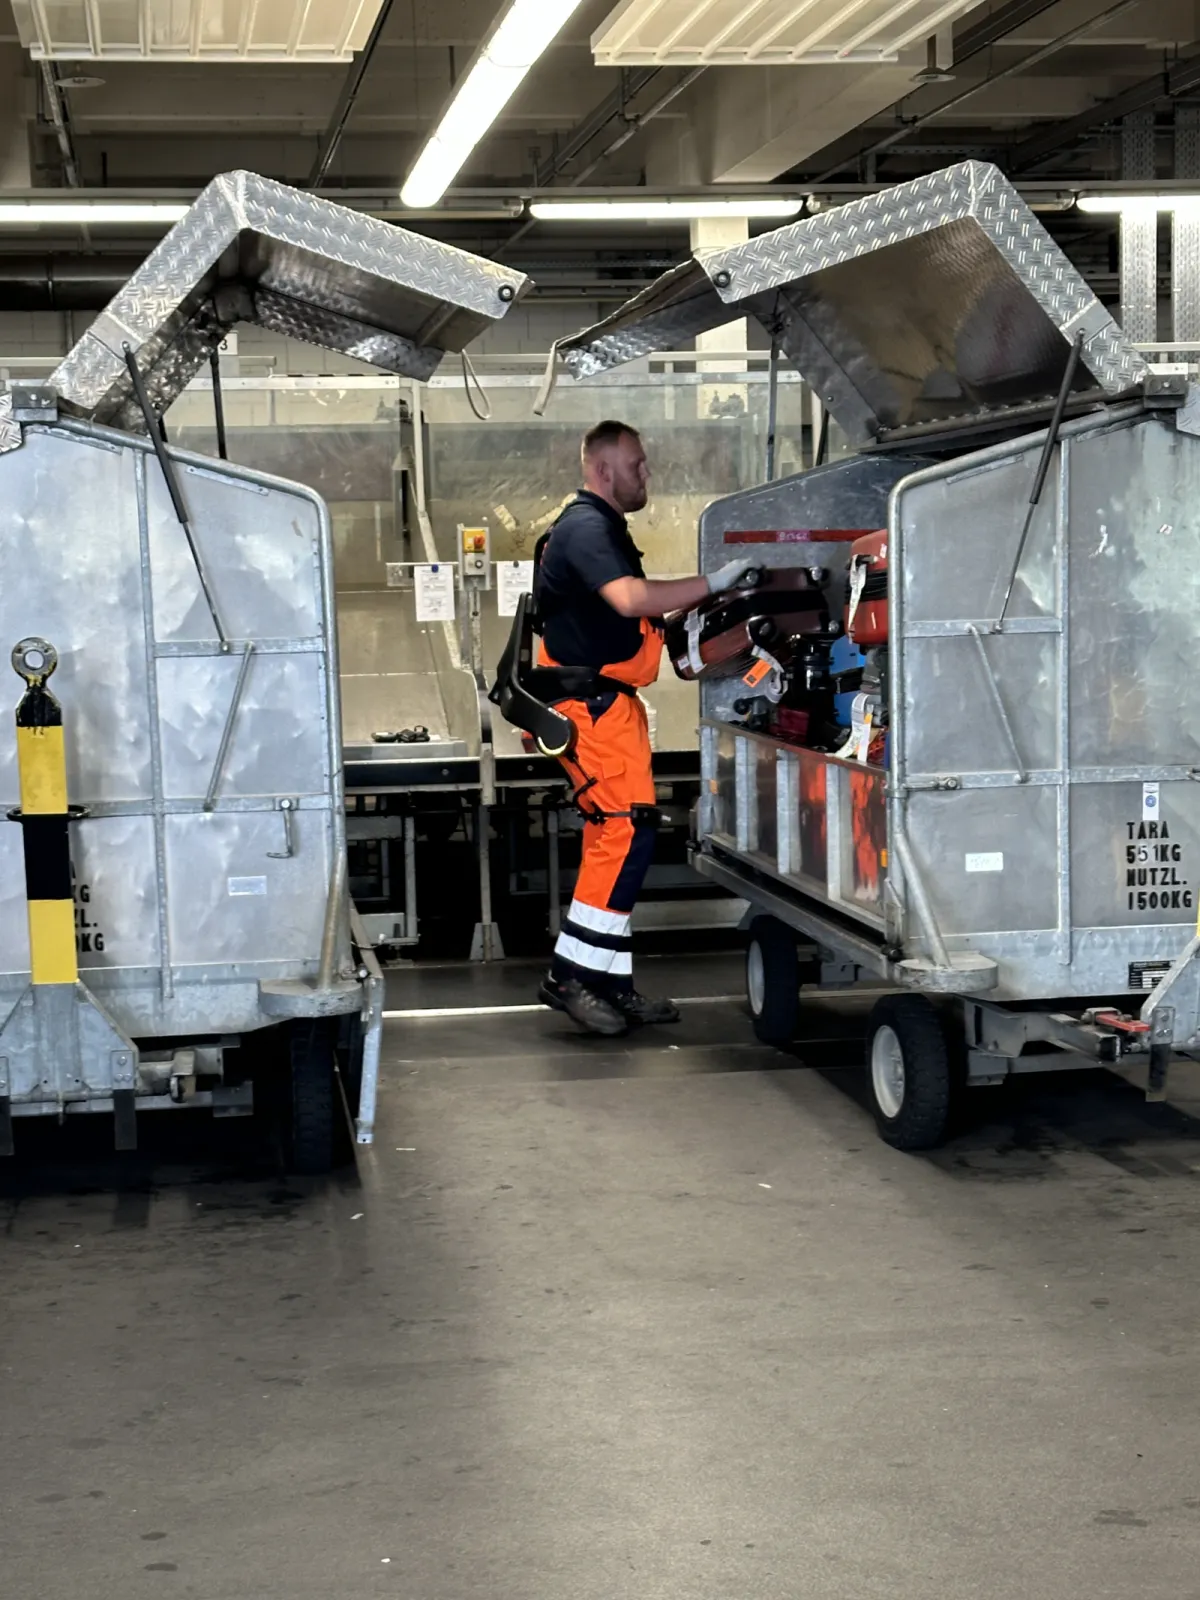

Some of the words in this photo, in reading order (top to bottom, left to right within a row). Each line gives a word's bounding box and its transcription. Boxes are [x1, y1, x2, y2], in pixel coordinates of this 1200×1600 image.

[1127, 821, 1169, 839] TARA
[1126, 844, 1181, 864] 551KG
[1126, 867, 1187, 886] NUTZL.
[1128, 890, 1192, 911] 1500KG
